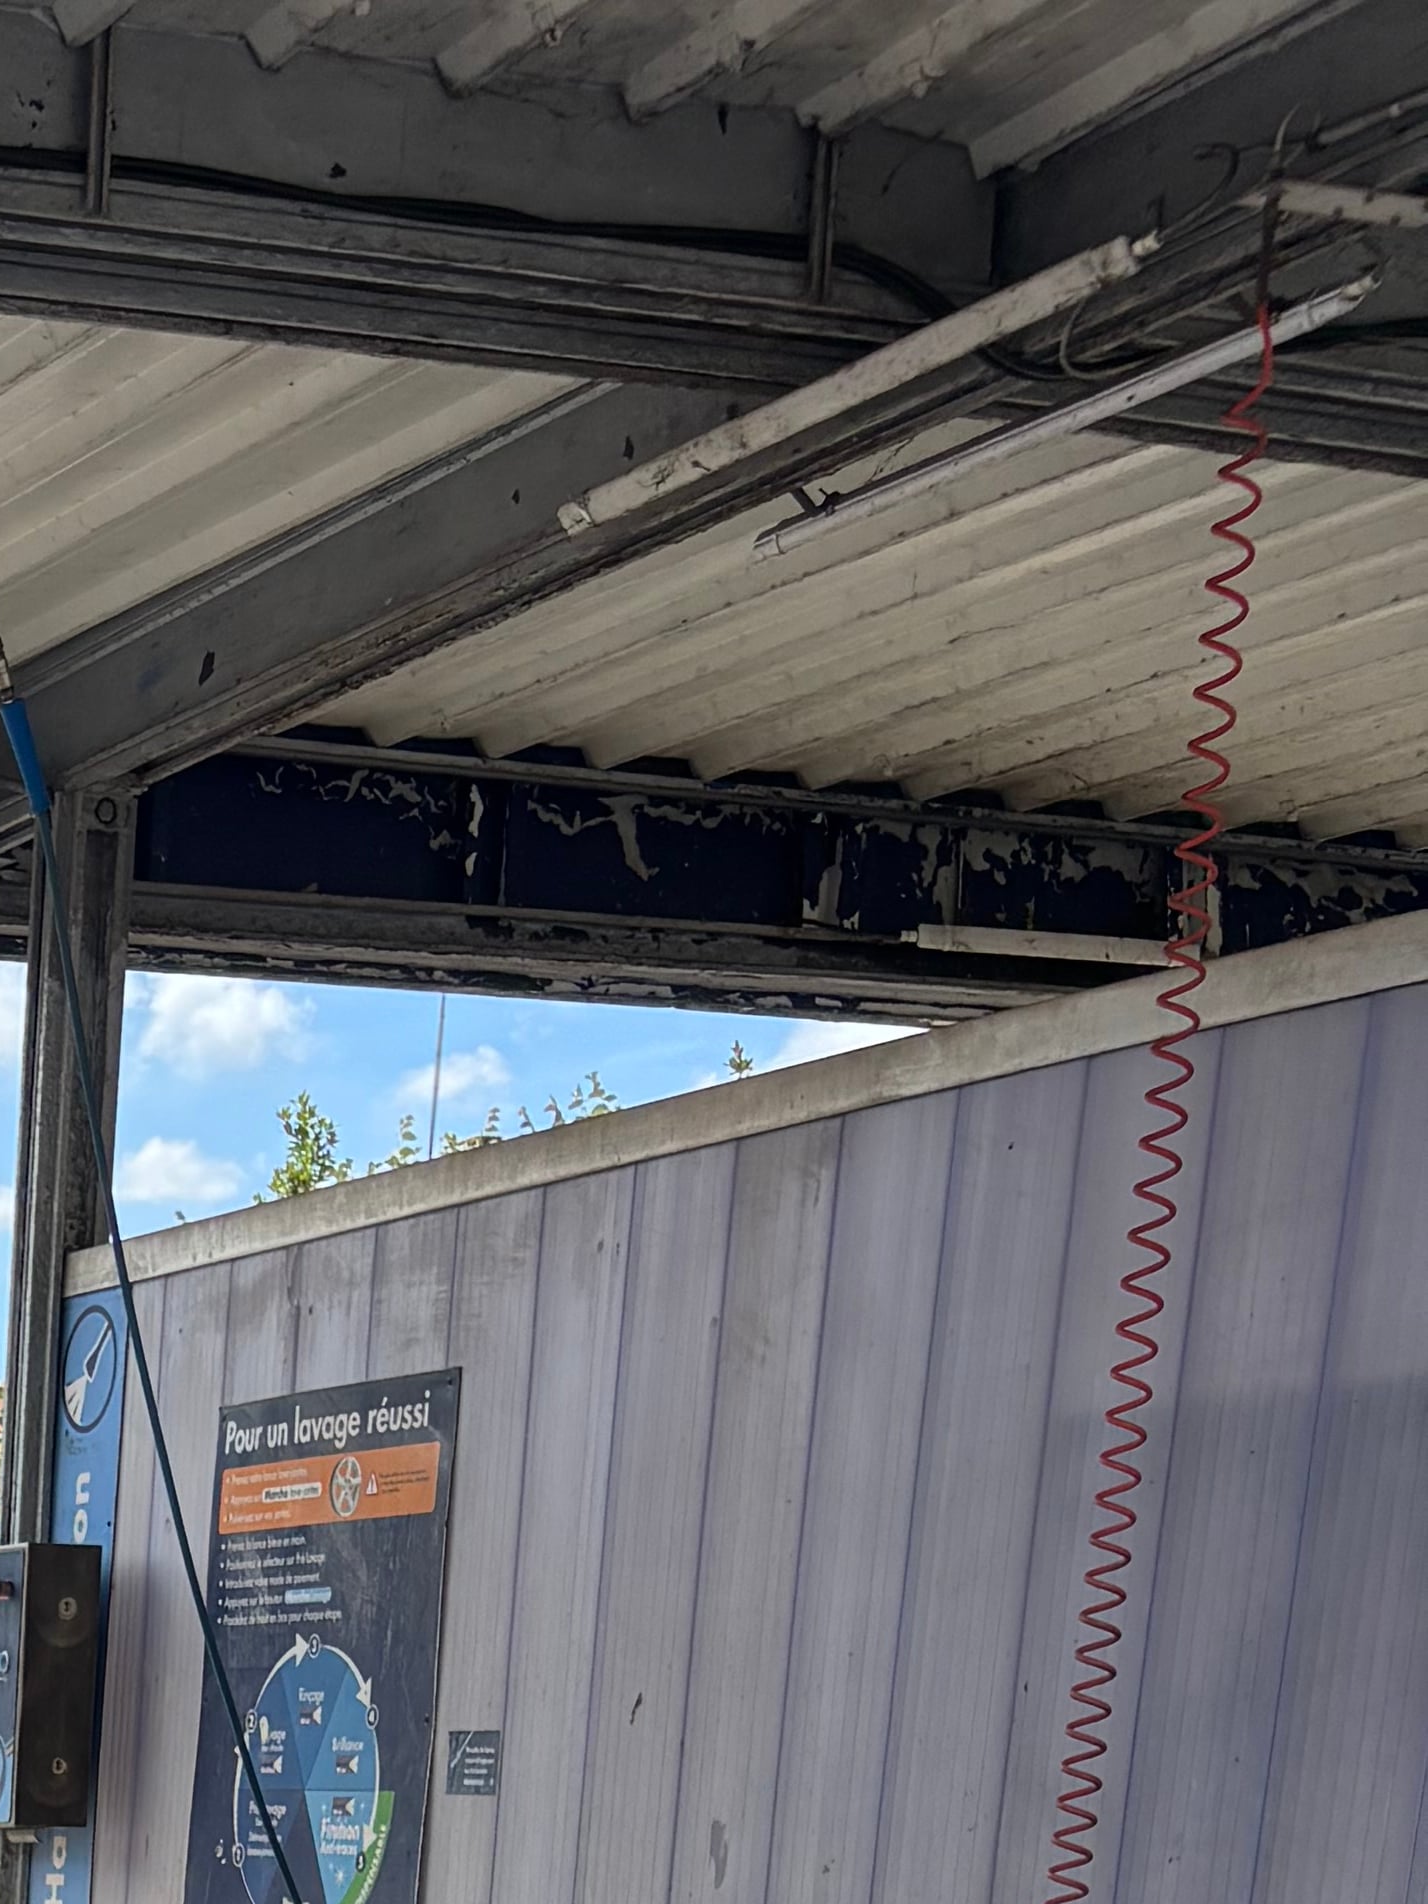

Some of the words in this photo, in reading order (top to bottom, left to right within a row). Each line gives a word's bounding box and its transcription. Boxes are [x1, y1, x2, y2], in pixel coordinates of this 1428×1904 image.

[225, 1420, 262, 1455] Pour
[266, 1419, 288, 1449] un
[294, 1405, 361, 1449] lavage
[366, 1389, 431, 1434] réussi
